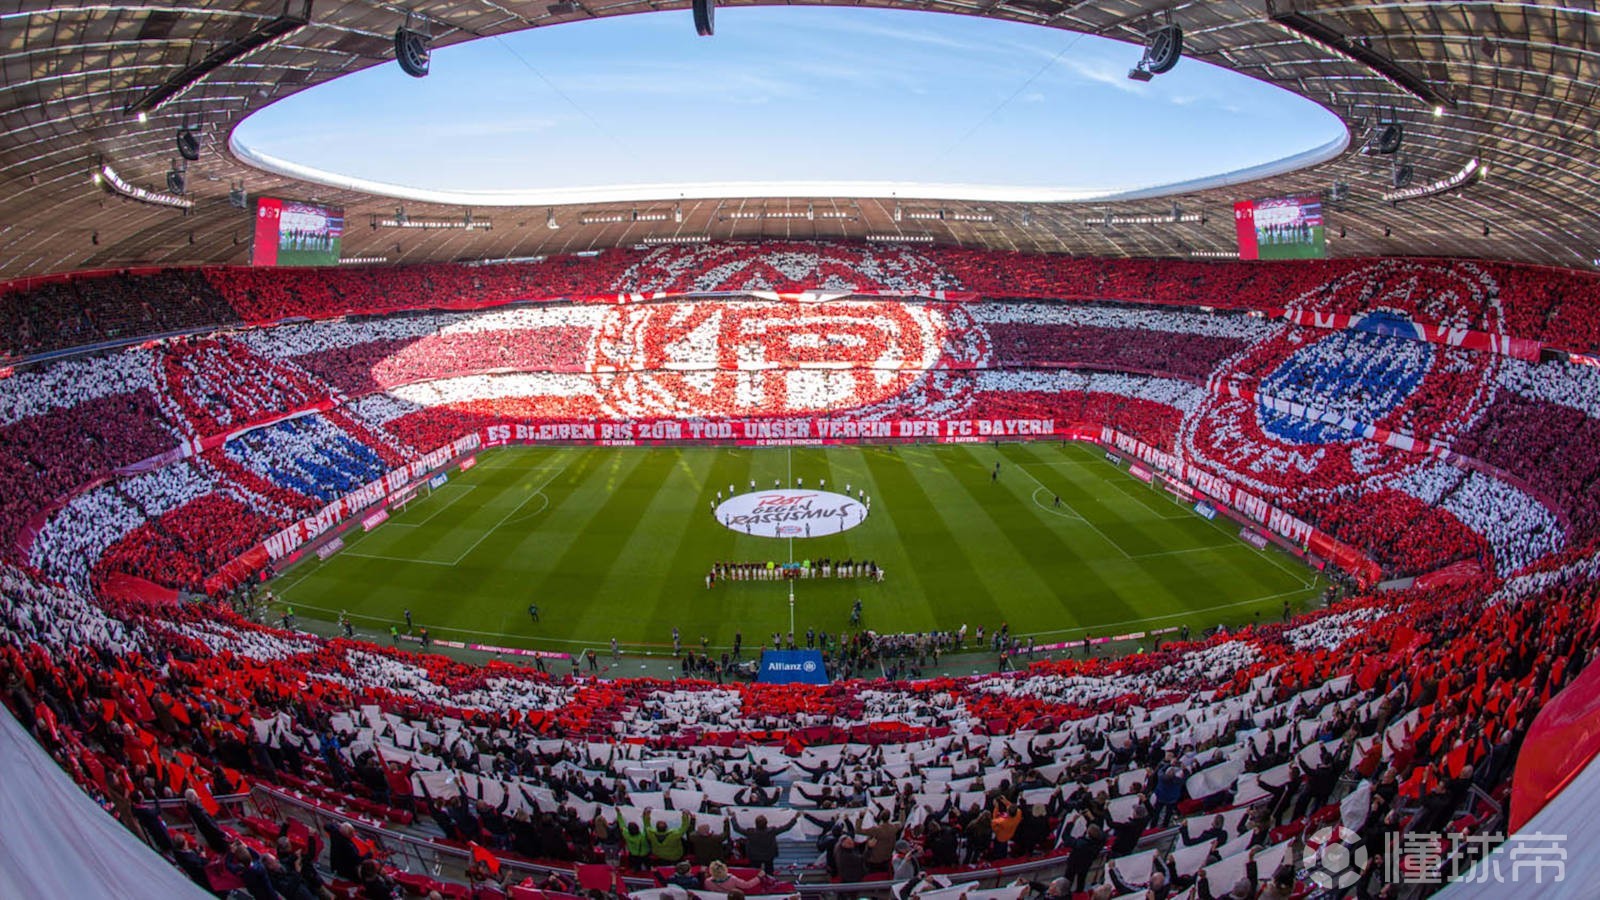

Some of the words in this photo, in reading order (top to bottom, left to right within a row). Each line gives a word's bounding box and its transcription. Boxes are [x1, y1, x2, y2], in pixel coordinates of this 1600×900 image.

[487, 424, 511, 441] ES
[516, 424, 595, 440] BLEIBEN
[602, 424, 633, 439] BIS
[639, 422, 682, 439] ZUM
[744, 422, 810, 438] UNSER
[817, 421, 892, 437] VEREIN
[900, 420, 939, 436] DER
[947, 420, 972, 436] FC
[978, 419, 1055, 435] BAYERN
[1137, 441, 1185, 479] FARBEN
[1186, 465, 1233, 504] WEISS
[1235, 488, 1269, 522] UND
[1268, 504, 1314, 543] ROT!
[729, 503, 856, 525] RASSISMUS
[752, 500, 813, 514] GEGEN
[303, 500, 343, 540] SEIT
[768, 662, 802, 671] Allianz
